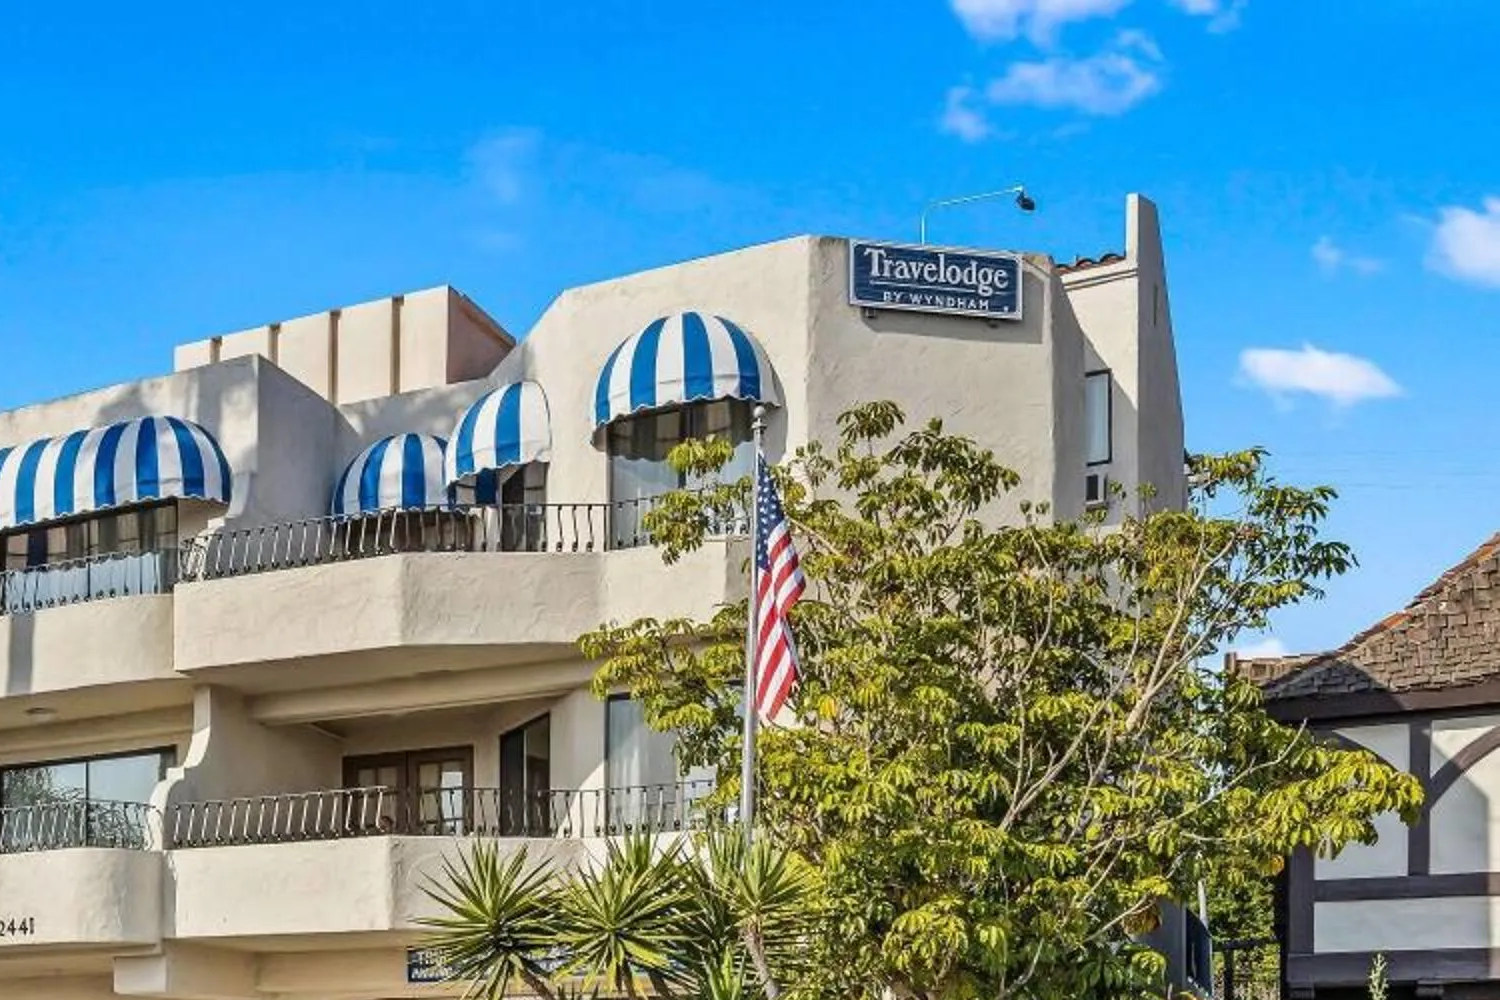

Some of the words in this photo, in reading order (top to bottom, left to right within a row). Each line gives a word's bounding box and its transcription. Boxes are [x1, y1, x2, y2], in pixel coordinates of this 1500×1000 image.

[863, 247, 1009, 297] Travelodge
[883, 291, 902, 303] BY
[909, 294, 990, 311] WYNDHAM
